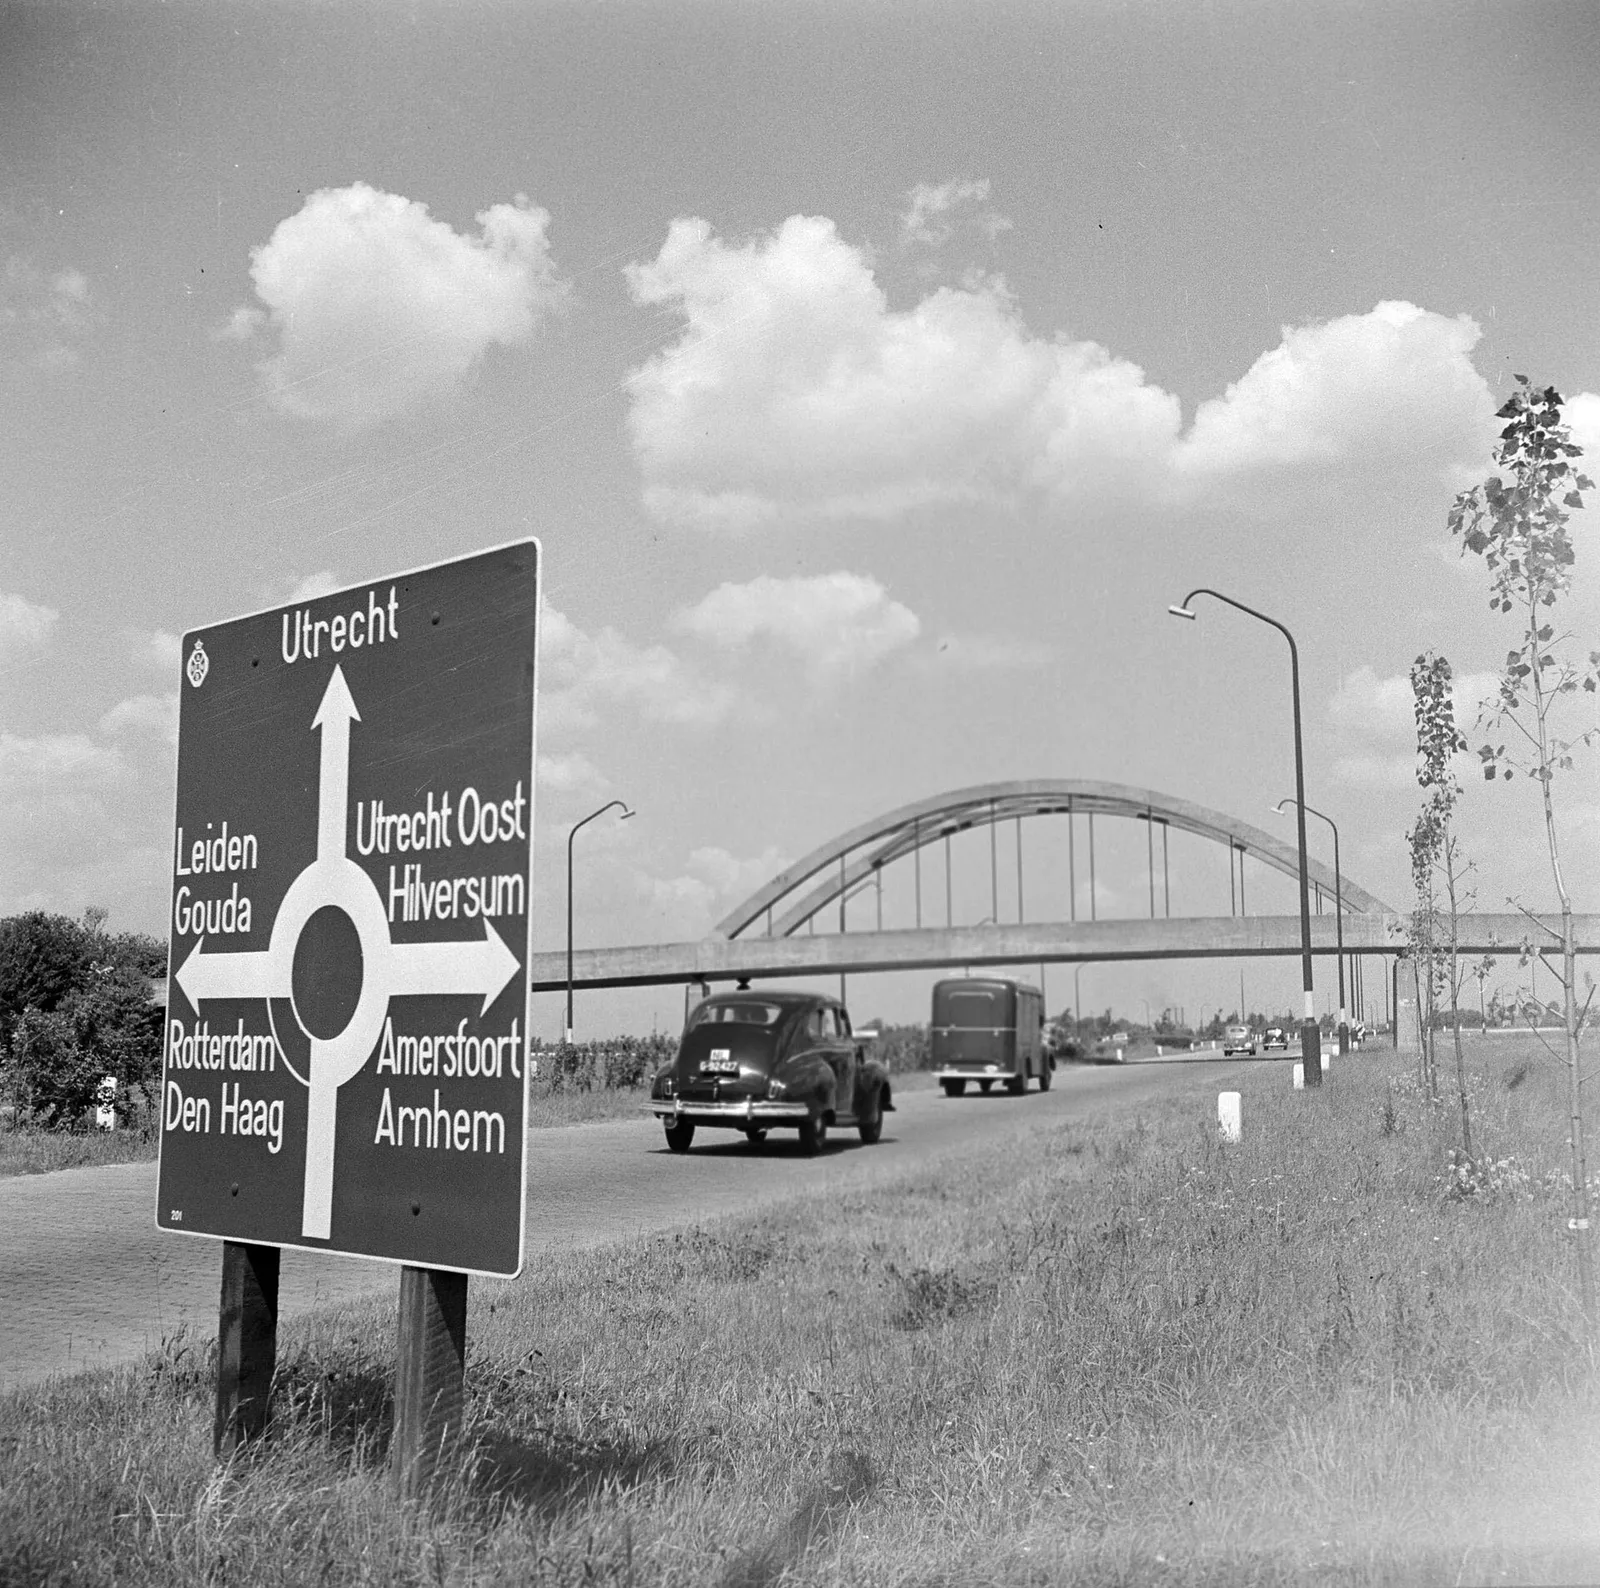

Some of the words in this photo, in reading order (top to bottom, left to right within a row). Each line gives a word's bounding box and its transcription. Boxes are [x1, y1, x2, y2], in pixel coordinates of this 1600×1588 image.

[281, 586, 399, 663] Utrecht
[356, 791, 452, 856] Utrecht
[458, 780, 526, 845] Oost
[176, 821, 257, 876] Leiden
[175, 883, 252, 936] Gouda
[388, 864, 524, 922] Hilversum
[169, 1018, 275, 1071] Rotterdam
[376, 1017, 521, 1078] Amersfoort
[166, 1081, 210, 1132] Den
[221, 1083, 284, 1154] Haag
[374, 1088, 505, 1154] Arnhem
[171, 1210, 182, 1220] 201
